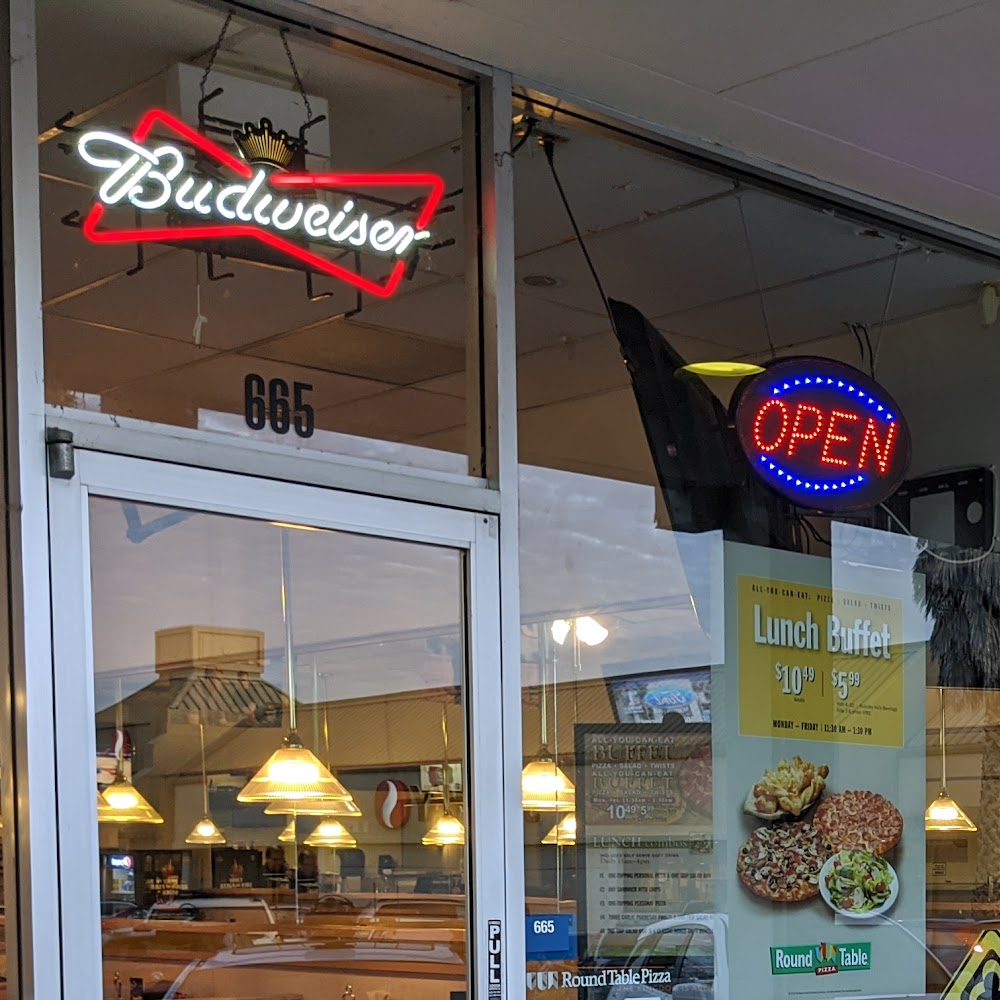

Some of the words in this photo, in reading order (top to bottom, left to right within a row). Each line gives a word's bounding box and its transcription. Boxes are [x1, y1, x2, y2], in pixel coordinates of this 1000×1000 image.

[77, 131, 430, 255] Budweiser
[243, 373, 315, 438] 665
[753, 397, 897, 475] OPEN
[753, 603, 820, 650] Lunch
[827, 614, 892, 659] Buffet
[773, 719, 794, 729] MONDAY
[801, 721, 819, 732] FRIDAY
[593, 836, 641, 848] LUNCH
[644, 837, 688, 848] combos
[533, 920, 555, 934] 665
[488, 925, 501, 983] PULL
[775, 948, 813, 968] Round
[838, 947, 868, 966] Table
[561, 970, 607, 988] Round
[607, 969, 640, 985] Table
[641, 968, 672, 984] Pizza
